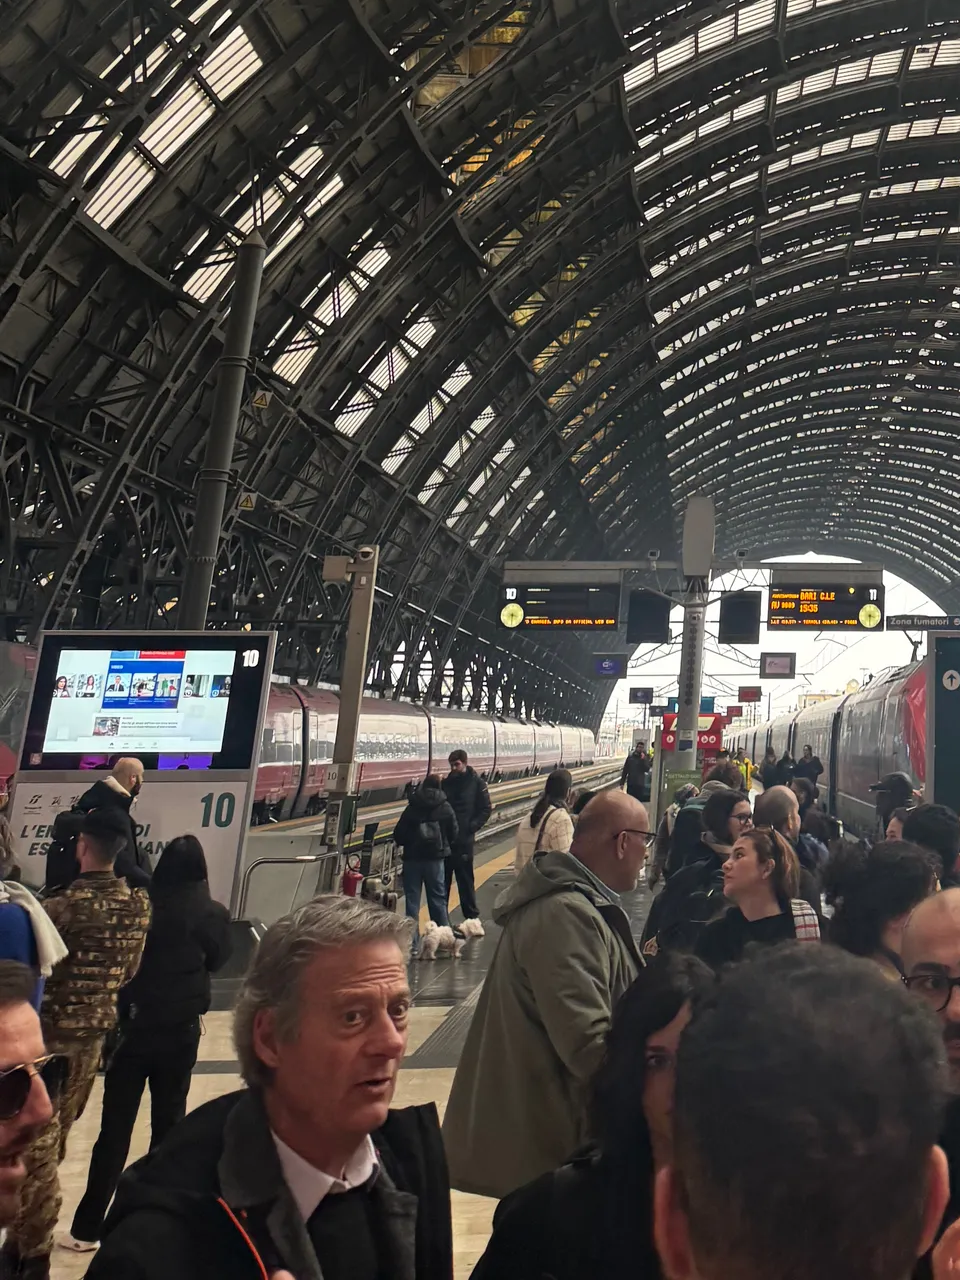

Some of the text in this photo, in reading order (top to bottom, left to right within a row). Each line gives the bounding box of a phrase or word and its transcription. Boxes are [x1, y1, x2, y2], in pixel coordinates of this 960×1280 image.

[506, 588, 517, 600] 10
[800, 592, 816, 600] BARI
[869, 589, 877, 600] 11
[800, 604, 818, 612] 15:35
[242, 650, 259, 668] 10
[328, 772, 337, 780] 10
[201, 792, 236, 828] 10
